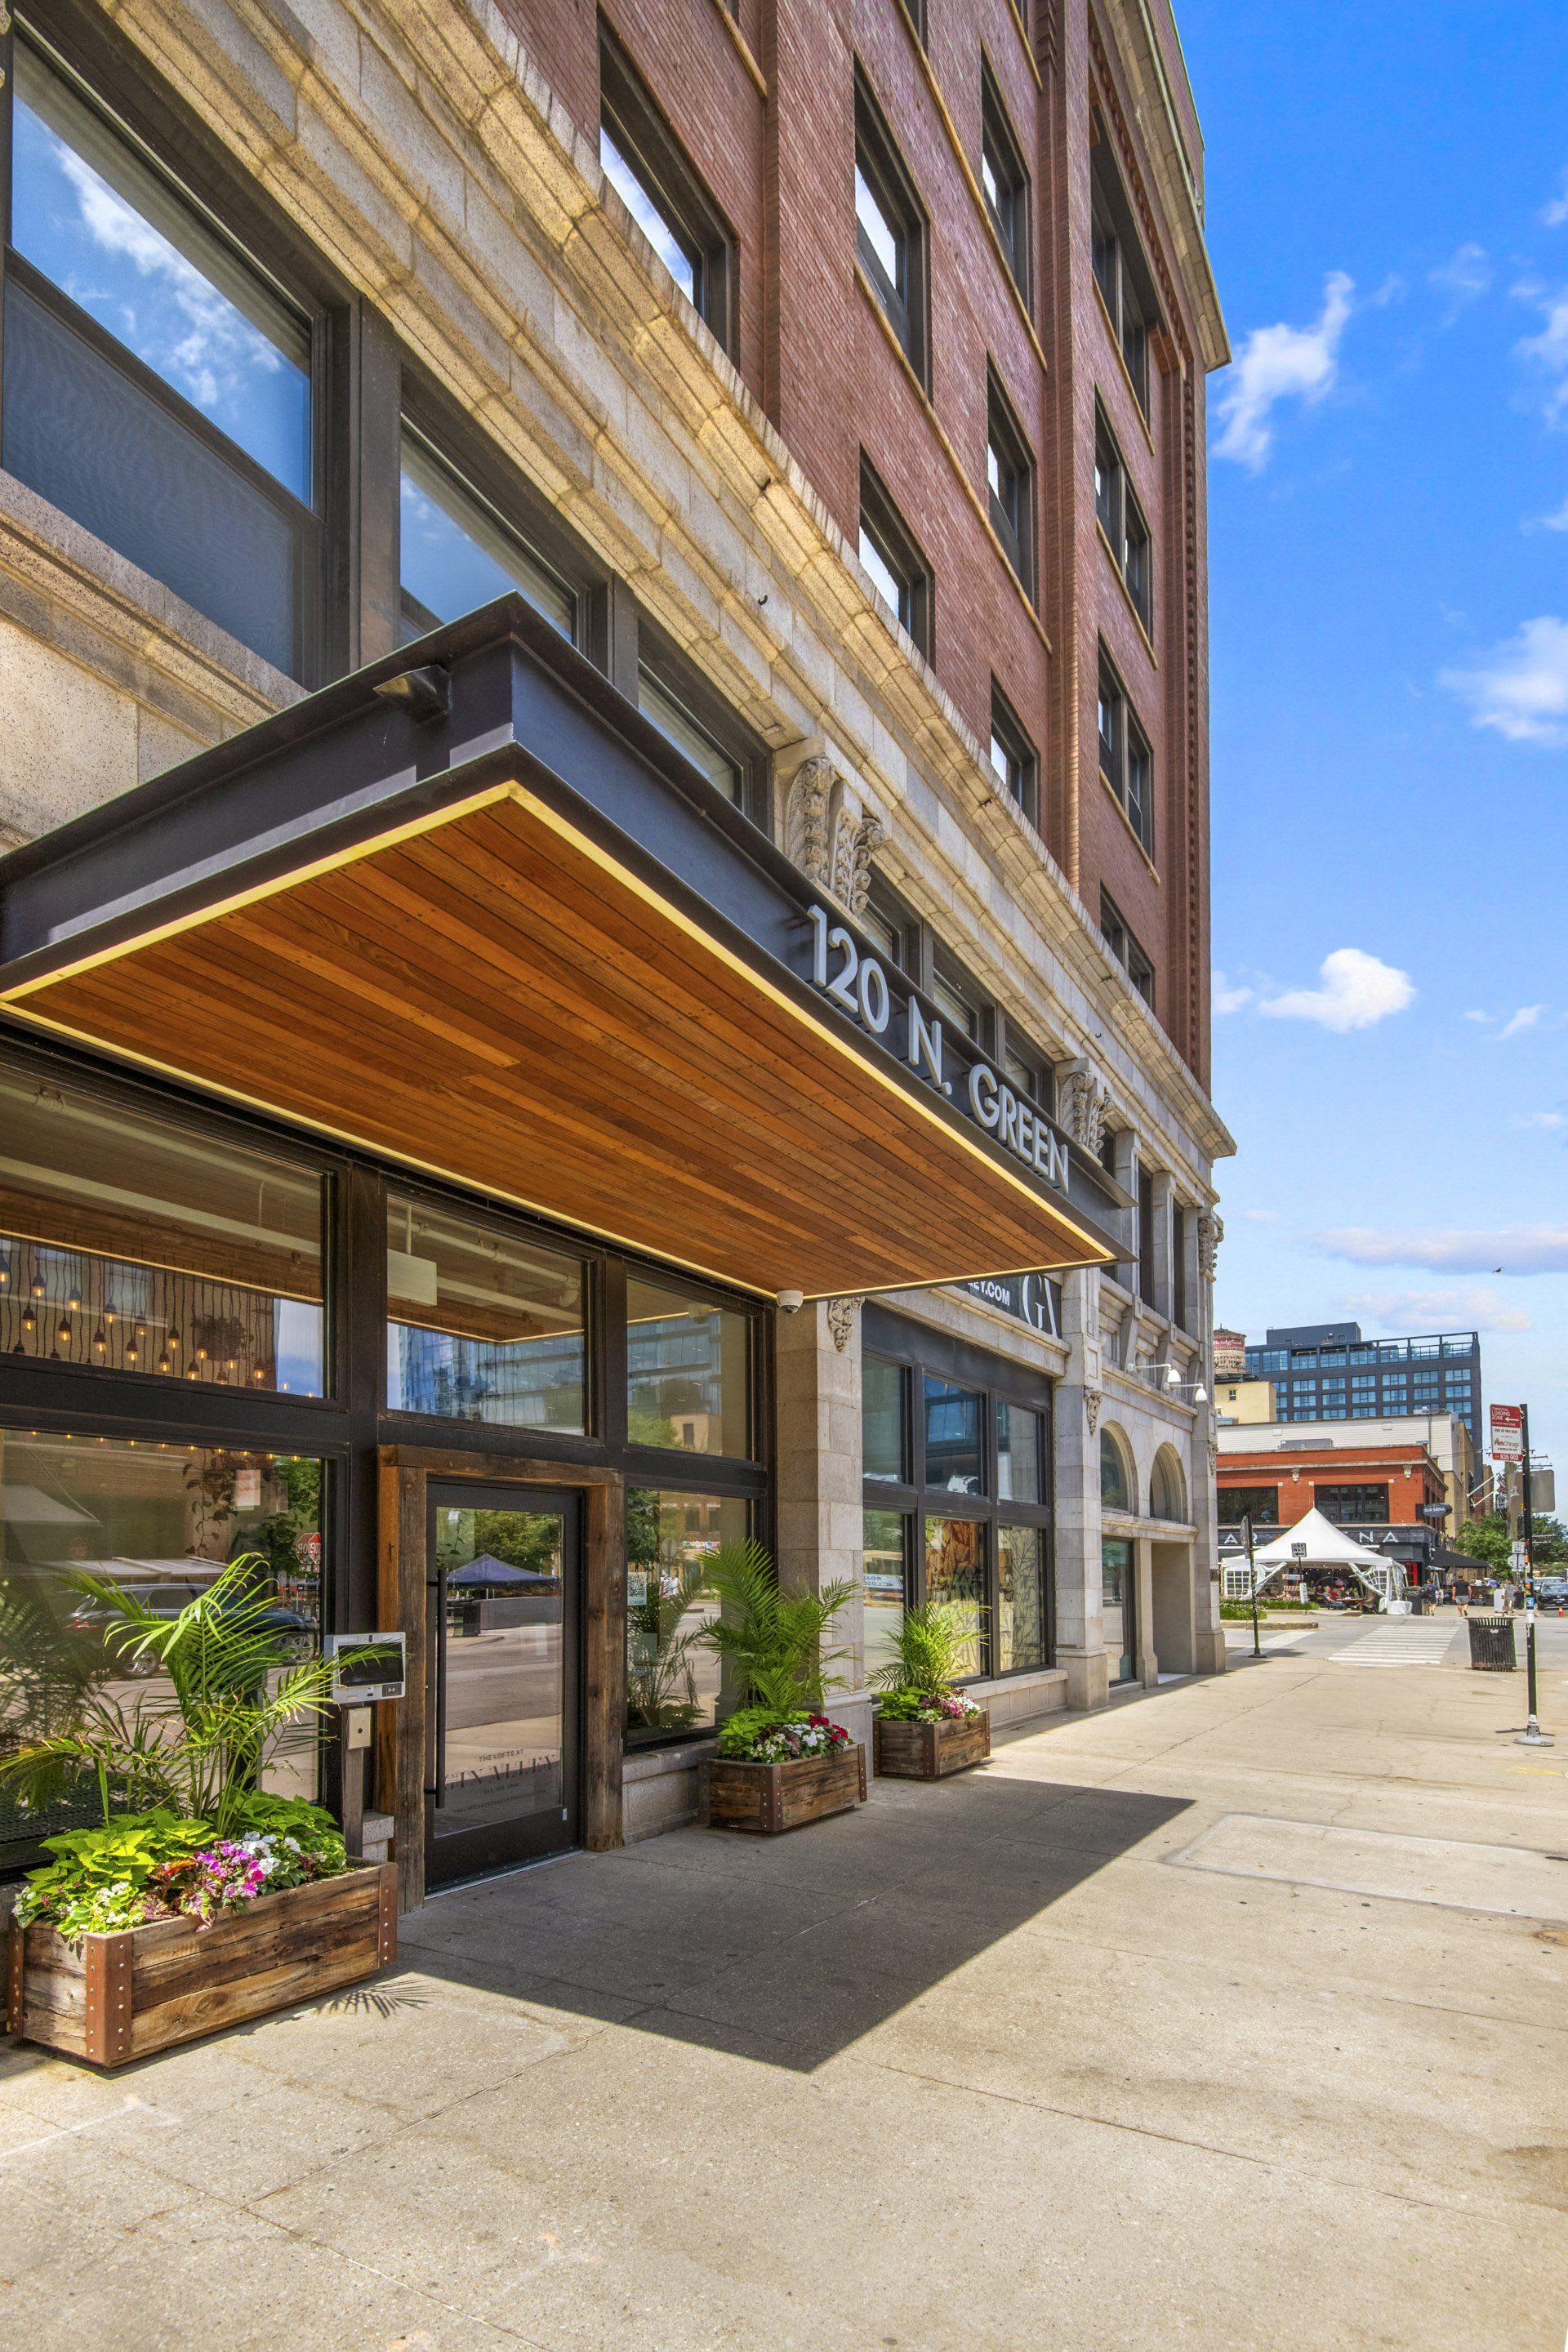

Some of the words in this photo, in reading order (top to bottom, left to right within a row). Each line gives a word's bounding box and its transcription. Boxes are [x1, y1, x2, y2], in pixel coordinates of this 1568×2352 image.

[807, 905, 889, 1033] 120
[908, 996, 952, 1096] N.
[969, 1064, 1069, 1194] GREEN
[493, 1750, 514, 1760] LOFTS
